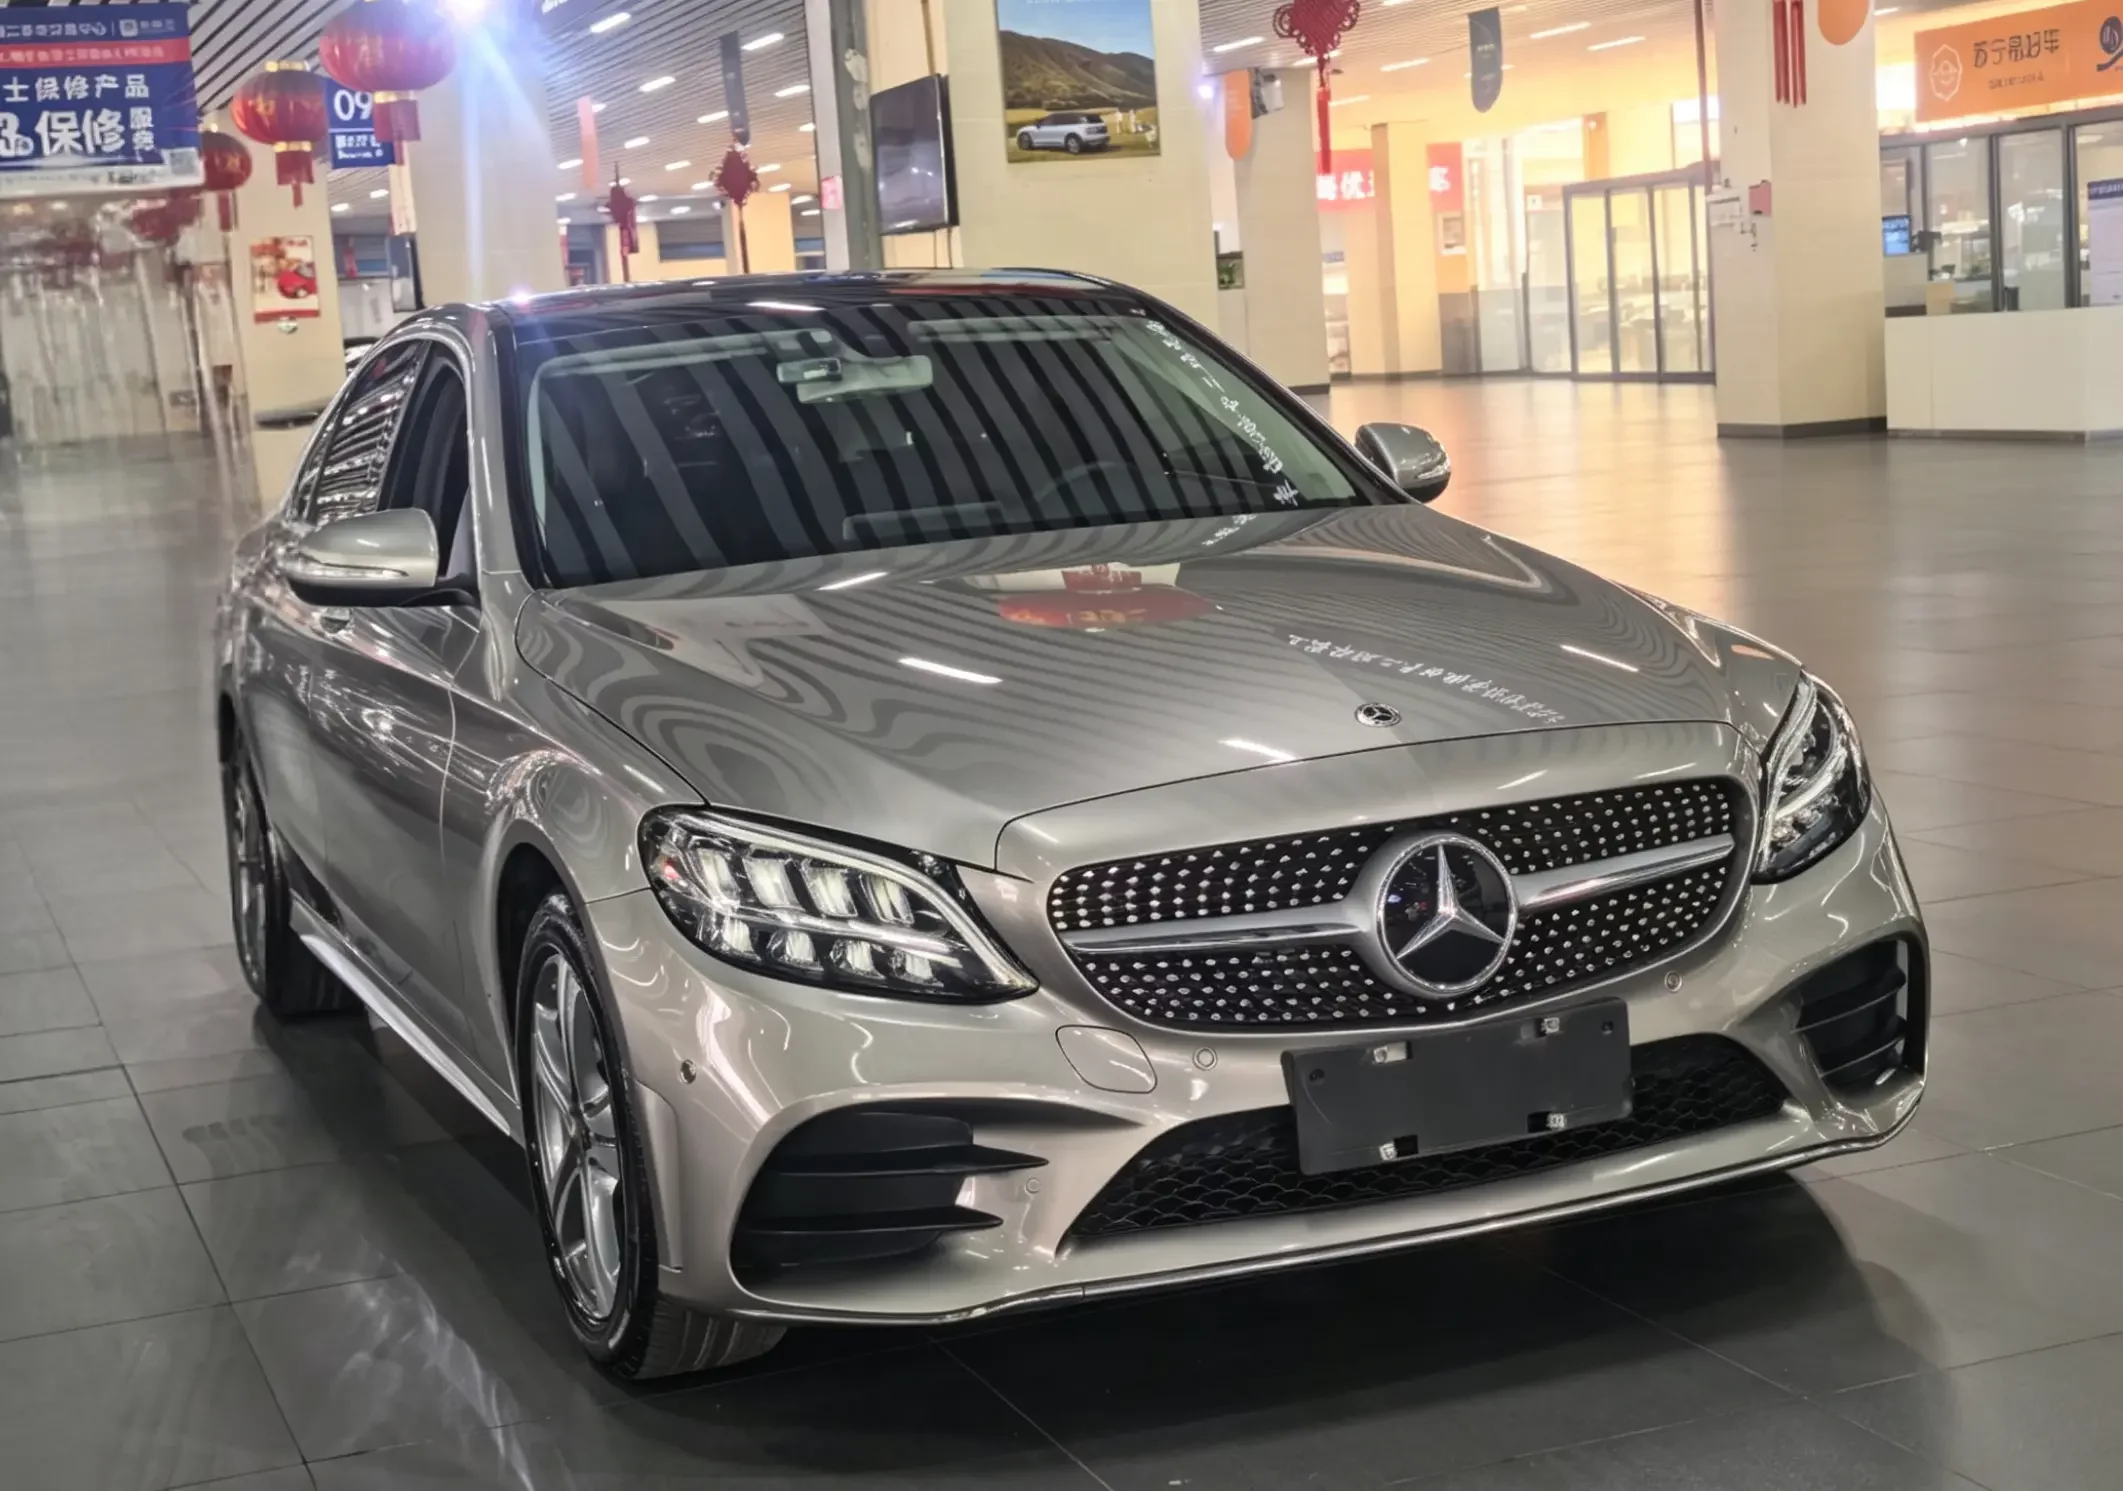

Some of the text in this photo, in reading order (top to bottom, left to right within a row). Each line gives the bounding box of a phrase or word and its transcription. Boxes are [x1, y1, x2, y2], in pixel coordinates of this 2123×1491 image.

[3, 74, 150, 102] 士保修产品
[333, 89, 372, 121] 09
